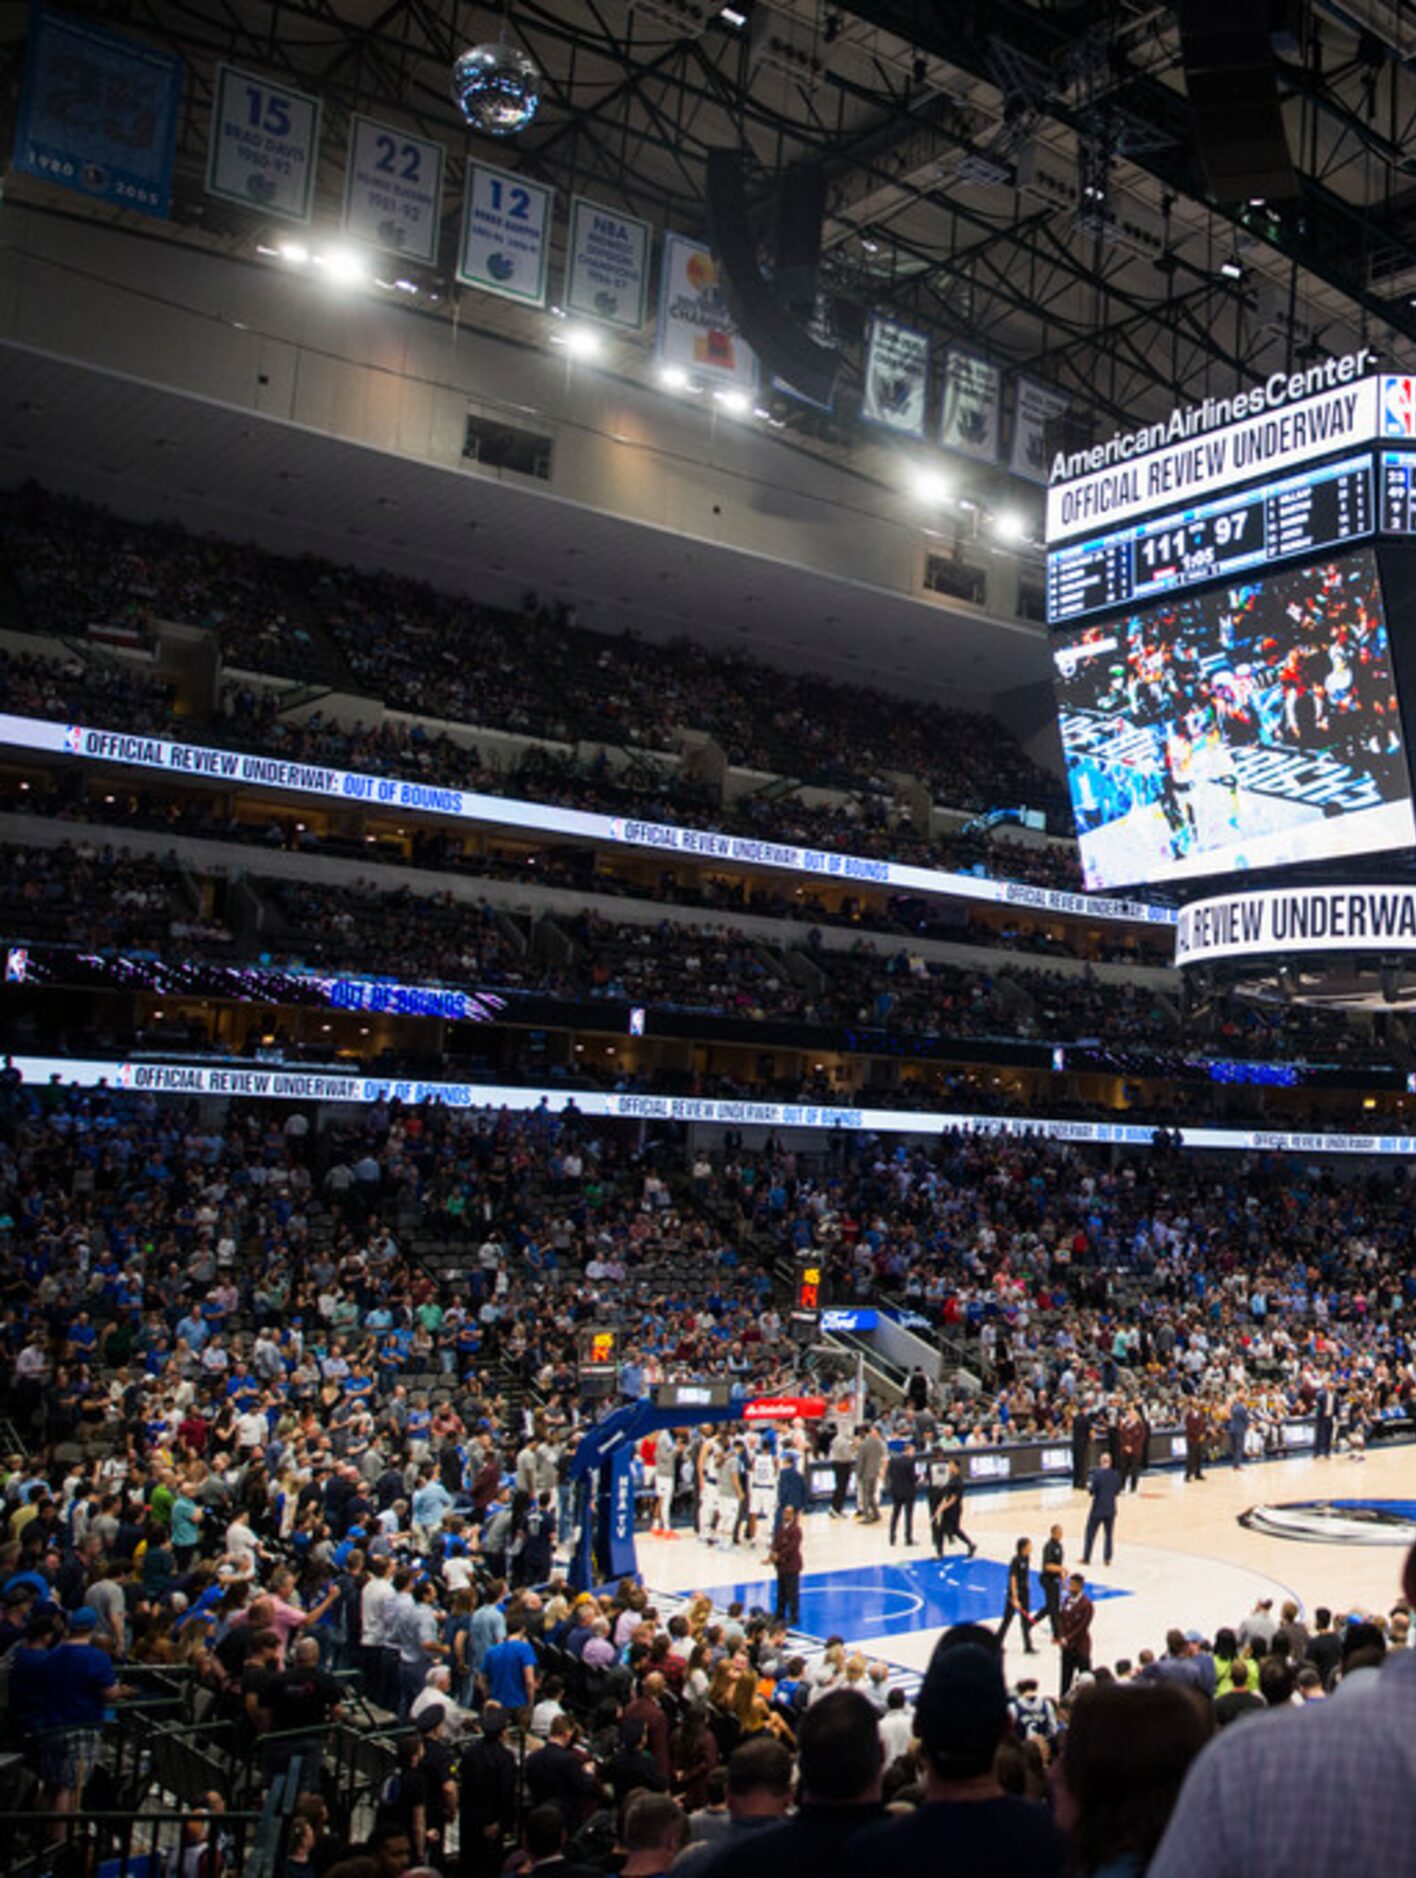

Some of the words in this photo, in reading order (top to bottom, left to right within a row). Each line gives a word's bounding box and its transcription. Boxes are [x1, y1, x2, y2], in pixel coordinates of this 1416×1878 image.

[245, 87, 290, 137] 15
[25, 150, 75, 176] 1980
[376, 135, 421, 182] 22
[490, 179, 531, 220] 12
[593, 216, 628, 241] NBA
[1061, 468, 1142, 525] OFFICIAL
[1147, 440, 1228, 498] REVIEW
[1232, 393, 1359, 469] UNDERWAY
[1142, 528, 1186, 566] 111
[1213, 511, 1248, 545] 97
[86, 732, 164, 763] OFFICIAL
[170, 746, 238, 776] REVIEW
[242, 758, 339, 792] UNDERWAY:
[343, 773, 374, 797] OUT
[378, 780, 398, 800] OF
[401, 785, 463, 812] BOUNDS
[624, 821, 679, 848] OFFICIAL
[682, 831, 730, 854] REVIEW
[804, 851, 826, 870] OUT
[828, 854, 842, 872] OF
[844, 857, 889, 881] BOUNDS
[1193, 899, 1264, 948] REVIEW
[135, 1066, 205, 1090] OFFICIAL
[209, 1072, 271, 1093] REVIEW
[273, 1076, 360, 1099] UNDERWAY:
[395, 1083, 412, 1099] OF
[618, 1097, 667, 1116] OFFICIAL
[671, 1100, 717, 1118] REVIEW
[782, 1106, 803, 1122] OUT
[806, 1107, 819, 1123] OF
[617, 1475, 629, 1511] NBA
[616, 1514, 627, 1539] TV
